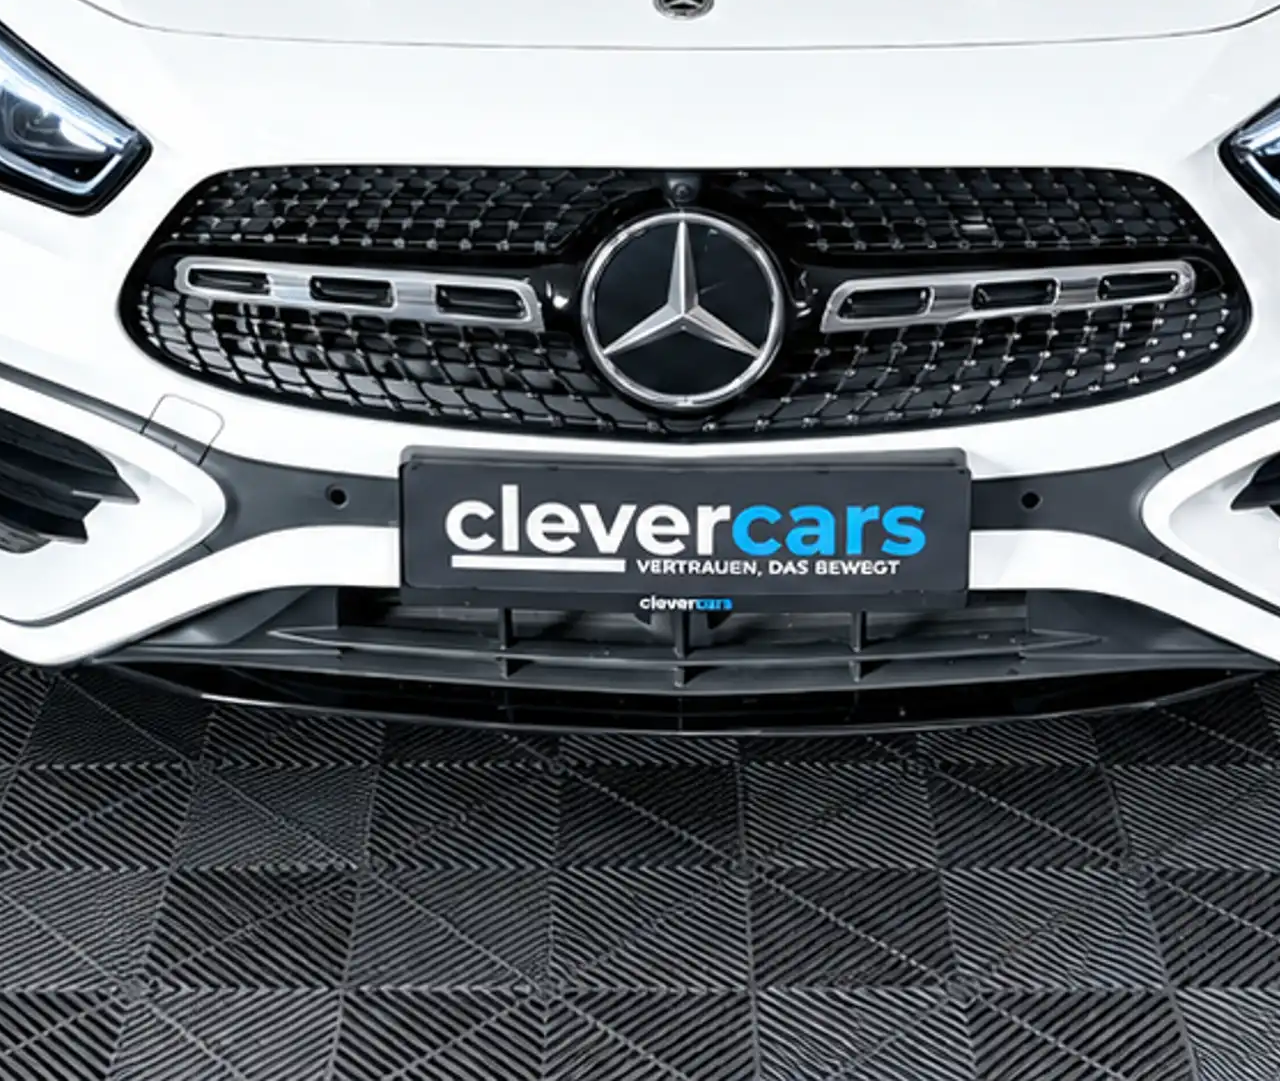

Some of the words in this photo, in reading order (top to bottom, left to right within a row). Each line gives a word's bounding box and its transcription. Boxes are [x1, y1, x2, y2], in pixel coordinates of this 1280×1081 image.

[444, 483, 927, 557] clevercars
[636, 558, 763, 577] VERTRAUEN,
[769, 559, 809, 576] DAS
[815, 559, 901, 576] BEWEGT
